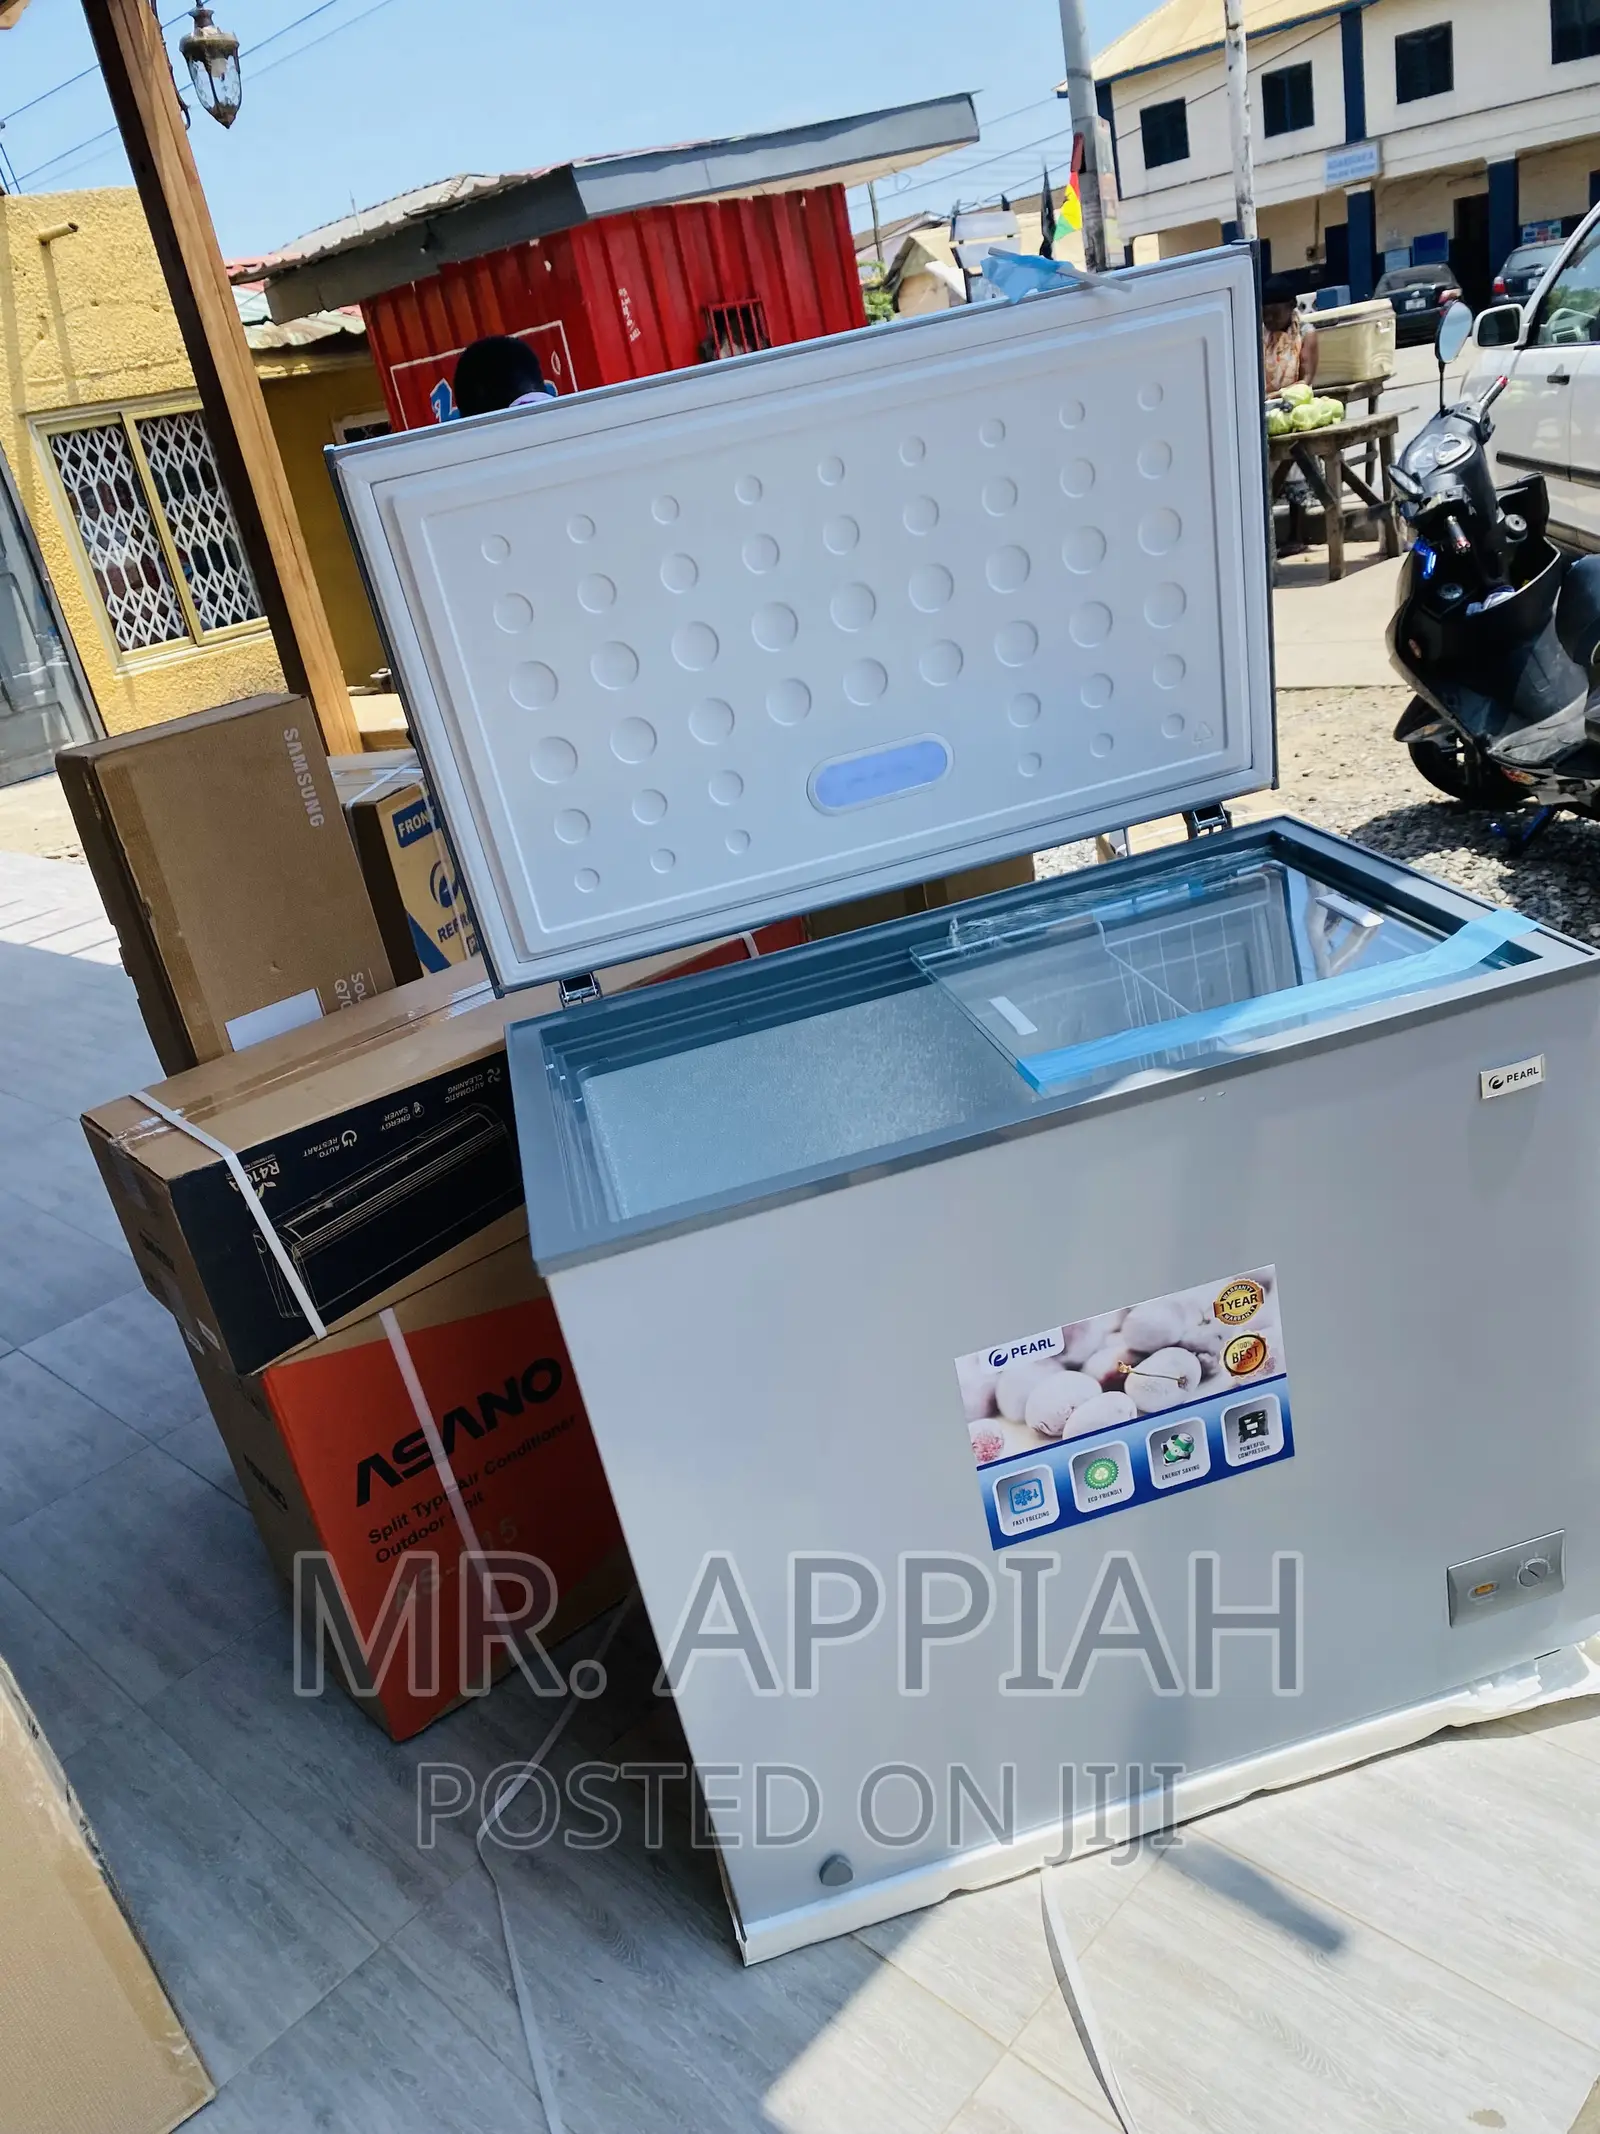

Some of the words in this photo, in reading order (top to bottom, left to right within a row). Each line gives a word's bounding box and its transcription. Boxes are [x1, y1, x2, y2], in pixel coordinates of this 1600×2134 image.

[284, 728, 324, 827] SAMSUNG
[398, 806, 434, 838] FRON
[1507, 1067, 1539, 1083] PEARL
[444, 1080, 485, 1104] AUTOMATIC
[447, 1074, 483, 1094] CLEANING
[384, 1106, 409, 1122] SAVER
[381, 1114, 411, 1132] ENERGY
[303, 1137, 338, 1157] RESTART
[319, 1145, 340, 1158] AUTO
[1222, 1284, 1254, 1301] WARRANTY
[1227, 1294, 1258, 1311] YEAR
[1224, 1304, 1257, 1321] WARRANTY
[1011, 1338, 1055, 1359] PEARL
[1231, 1346, 1260, 1364] BEST
[356, 1357, 563, 1508] ASANO
[1237, 1445, 1271, 1460] COMPRESSOR
[1239, 1440, 1265, 1452] POWERFUL
[368, 1513, 410, 1544] Split
[457, 1471, 481, 1491] Air
[484, 1415, 576, 1476] Conditioner
[1161, 1469, 1181, 1480] ENERGY
[1182, 1463, 1200, 1475] SAVING
[1087, 1488, 1123, 1504] ECO-FRIENDLY
[375, 1515, 447, 1563] Outdoor
[450, 1491, 485, 1518] nit
[1012, 1519, 1026, 1527] FAST
[1026, 1510, 1050, 1523] FREEZING
